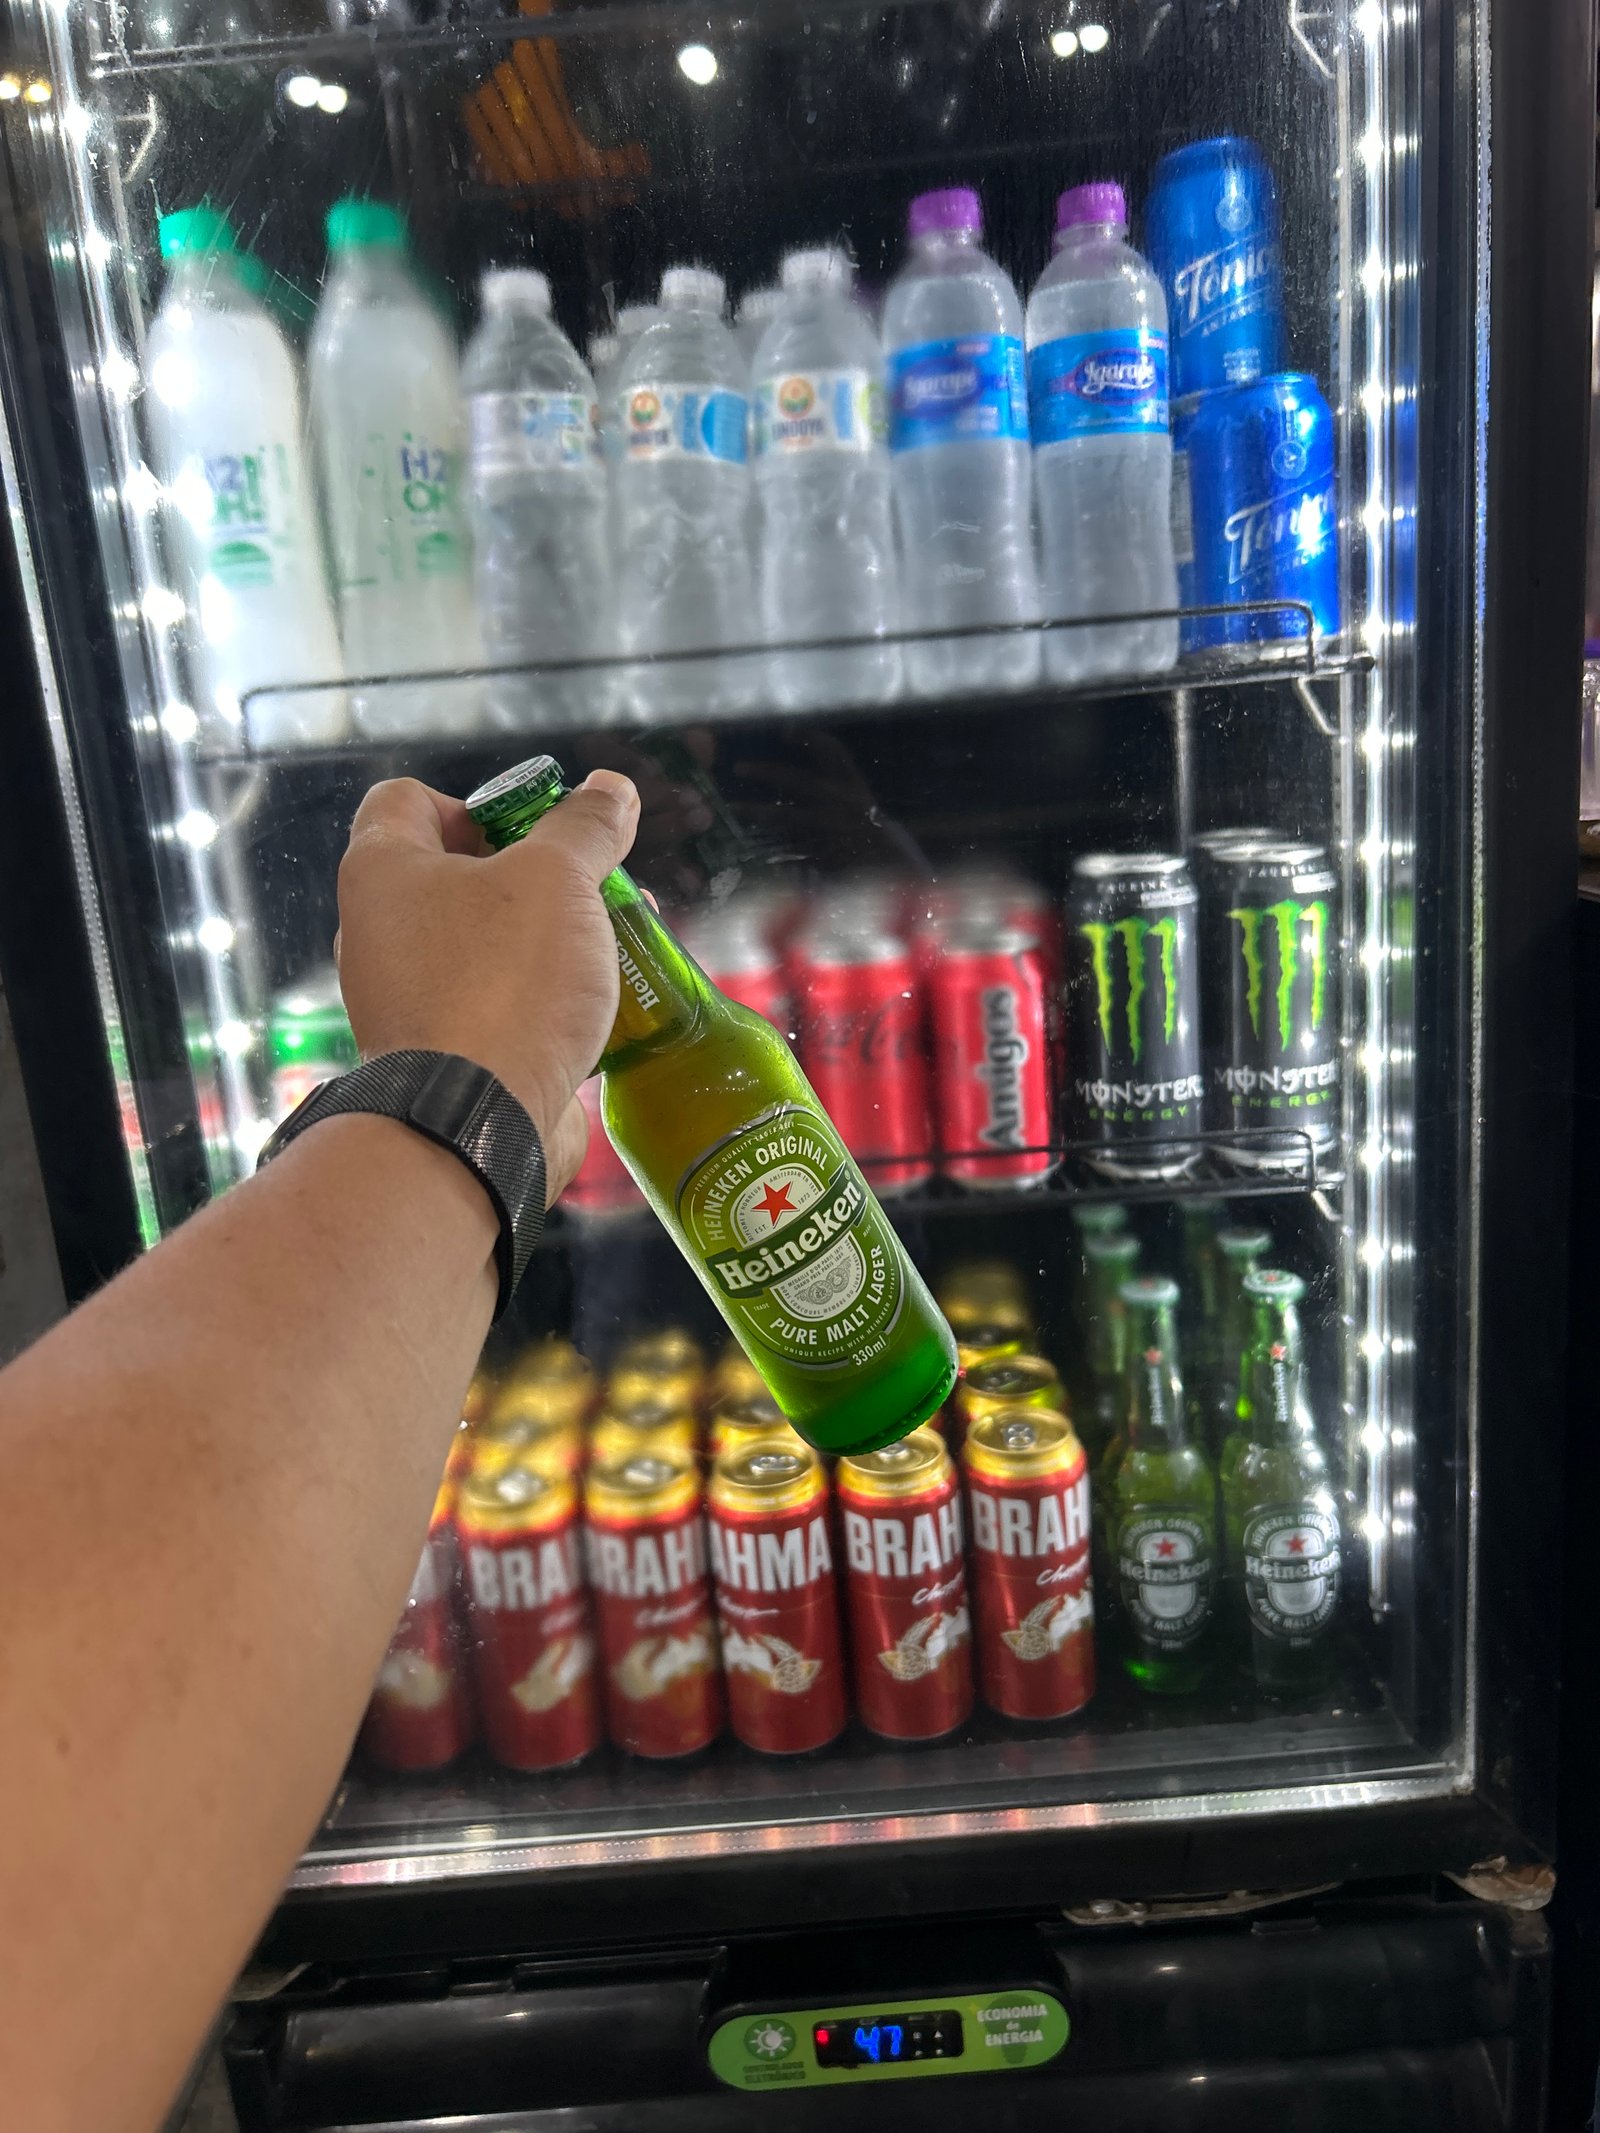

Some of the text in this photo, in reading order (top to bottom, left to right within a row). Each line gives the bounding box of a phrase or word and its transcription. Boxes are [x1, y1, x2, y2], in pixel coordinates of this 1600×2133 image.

[694, 1163, 721, 1193] PREMIUM
[722, 1139, 752, 1163] QUALITY
[754, 1126, 777, 1142] LAGER
[703, 1135, 828, 1241] HEINEKEN ORIGINAL
[769, 1170, 802, 1183] AMSTERDAM
[798, 1192, 811, 1205] 1873
[715, 1181, 863, 1291] Heineken
[754, 1223, 769, 1235] EST.
[753, 1302, 770, 1312] TRADE
[769, 1244, 886, 1345] PURE MALT LAGER
[783, 1345, 814, 1357] UNIQUE
[817, 1345, 845, 1357] RECIPE
[846, 1334, 865, 1349] WITH
[866, 1302, 891, 1334] HEINEKEN
[852, 1334, 887, 1366] 330ml
[976, 2003, 1048, 2022] ECONOMIA
[985, 2029, 1044, 2047] ENERGIA
[1006, 2020, 1020, 2031] de
[855, 2025, 903, 2063] 47
